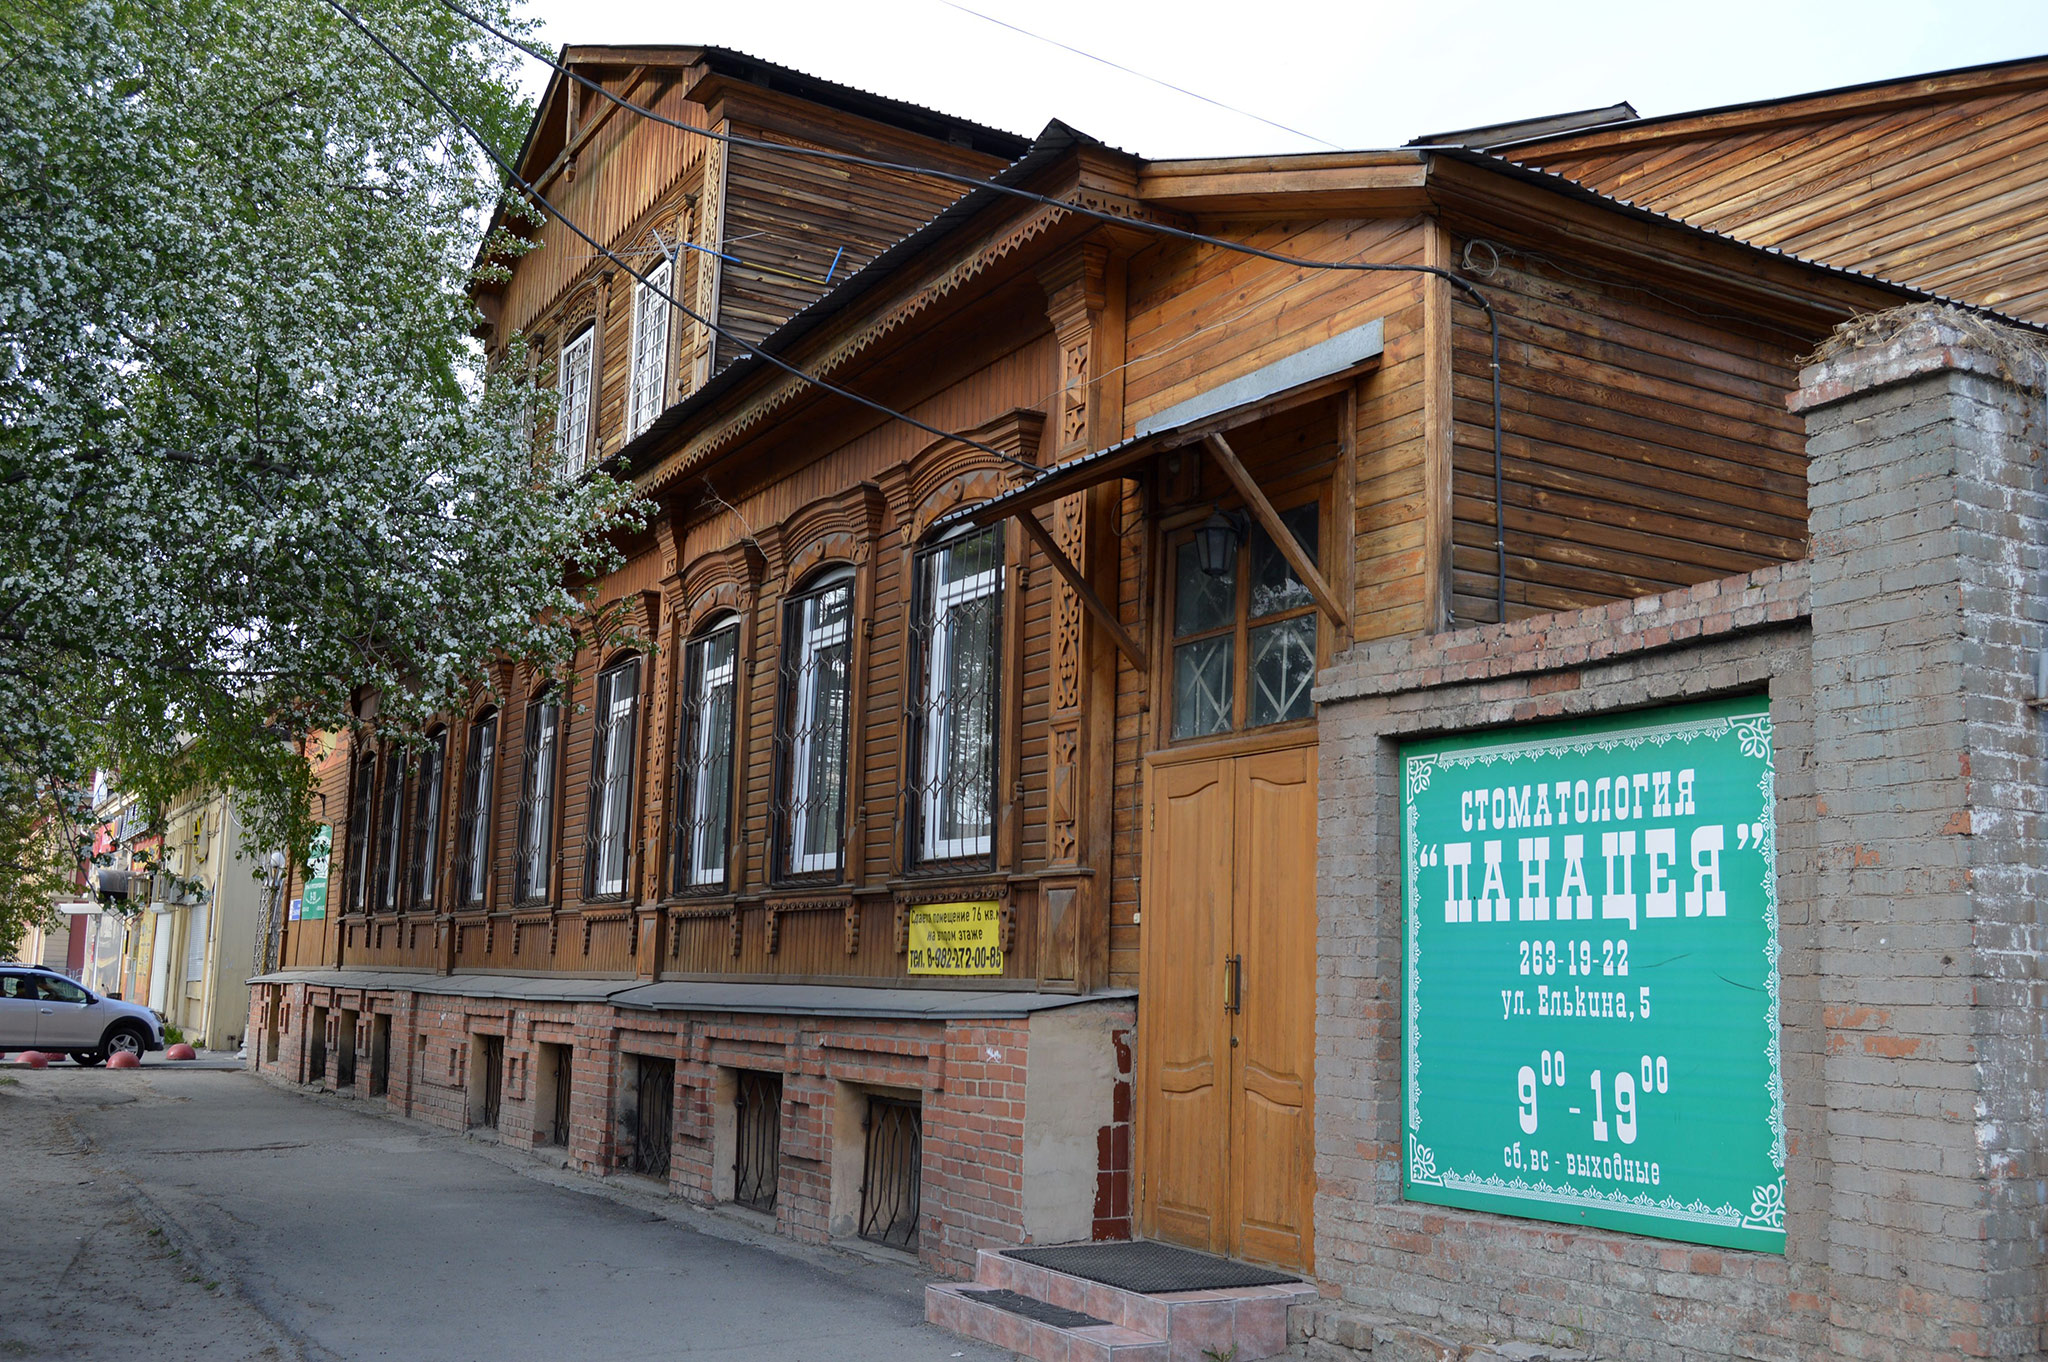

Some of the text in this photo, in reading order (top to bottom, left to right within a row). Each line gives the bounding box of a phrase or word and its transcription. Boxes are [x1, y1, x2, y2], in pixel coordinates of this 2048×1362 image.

[1461, 768, 1696, 832] СТОМАТОЛОГИЯ
[932, 911, 970, 925] помещение
[972, 906, 982, 921] 76
[927, 930, 936, 941] на
[958, 928, 983, 941] этаже
[909, 946, 1001, 969] тел. 8-982-272-00-85
[1518, 940, 1629, 977] 263-19-22
[1501, 984, 1651, 1022] ул. Елькина, 5
[1503, 1141, 1549, 1173] сб,вс
[1566, 1152, 1661, 1186] выходные
